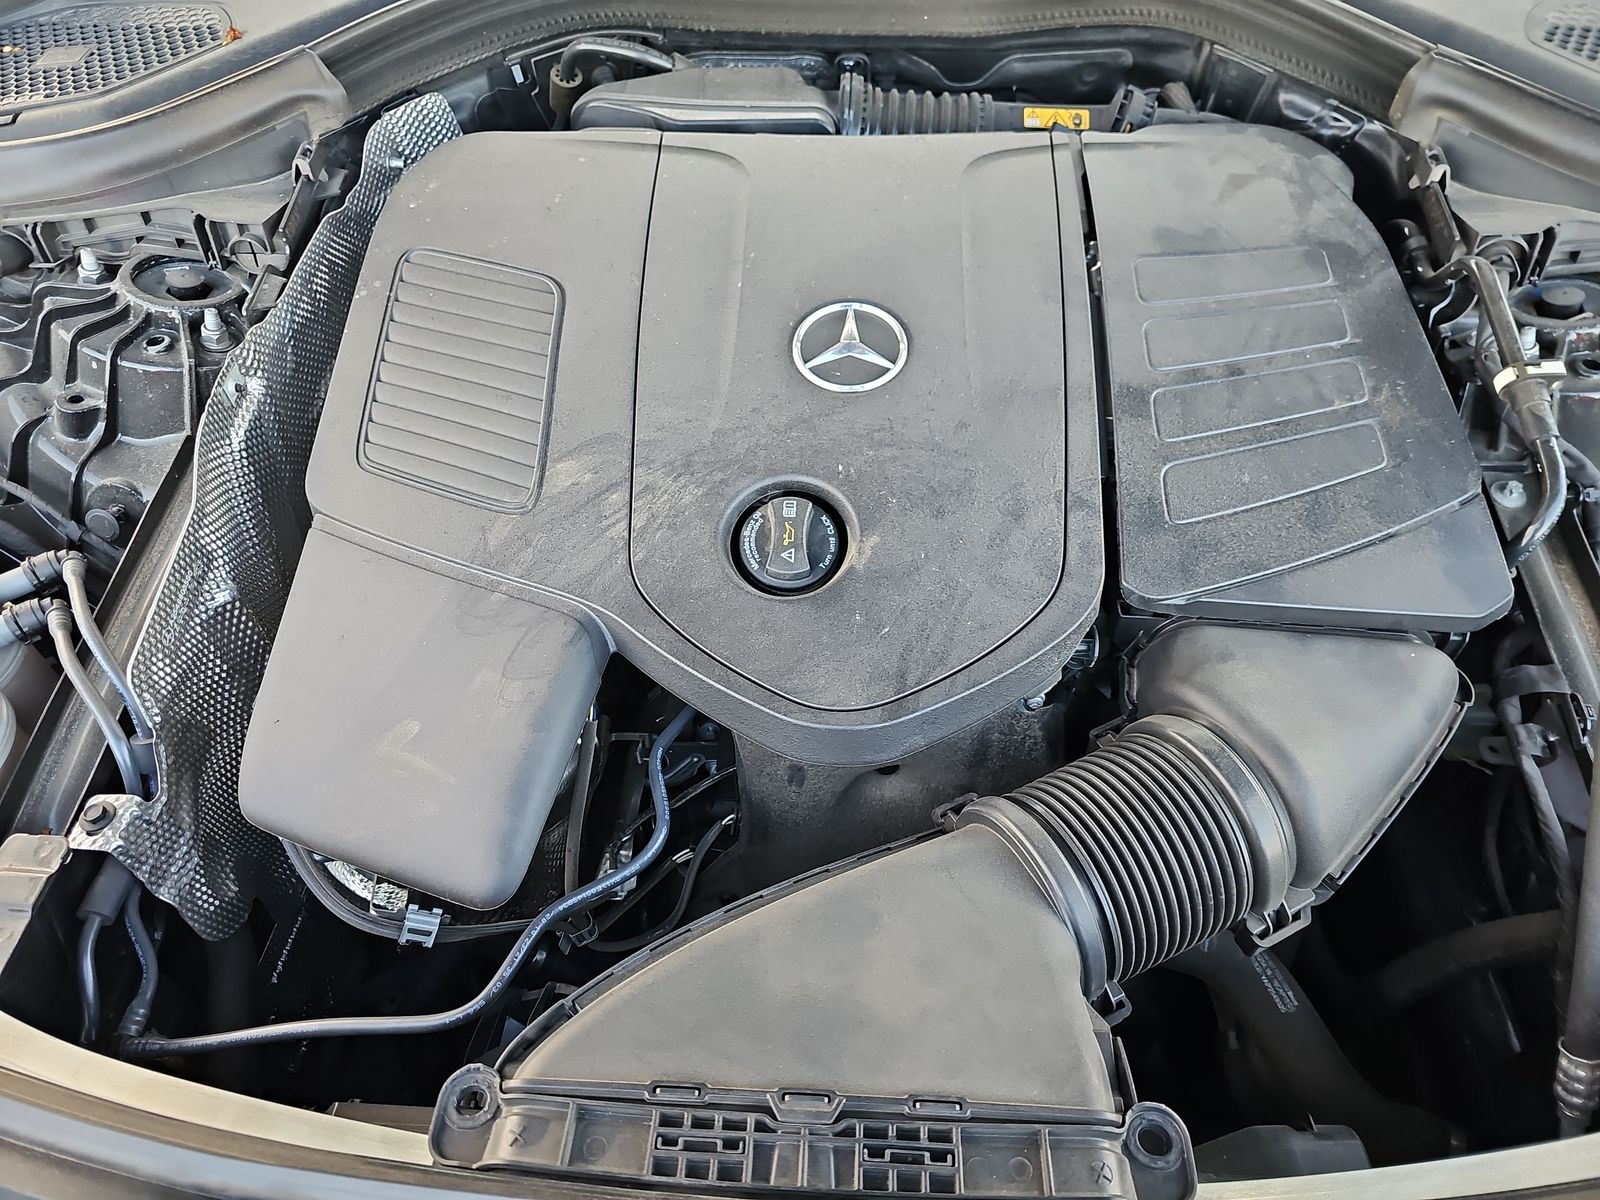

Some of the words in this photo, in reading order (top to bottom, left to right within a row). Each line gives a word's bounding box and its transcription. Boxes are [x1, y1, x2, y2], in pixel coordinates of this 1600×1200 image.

[820, 514, 835, 535] CLICK
[742, 519, 760, 571] Mercedes-Benz
[828, 537, 836, 553] until
[818, 554, 833, 570] Turn
